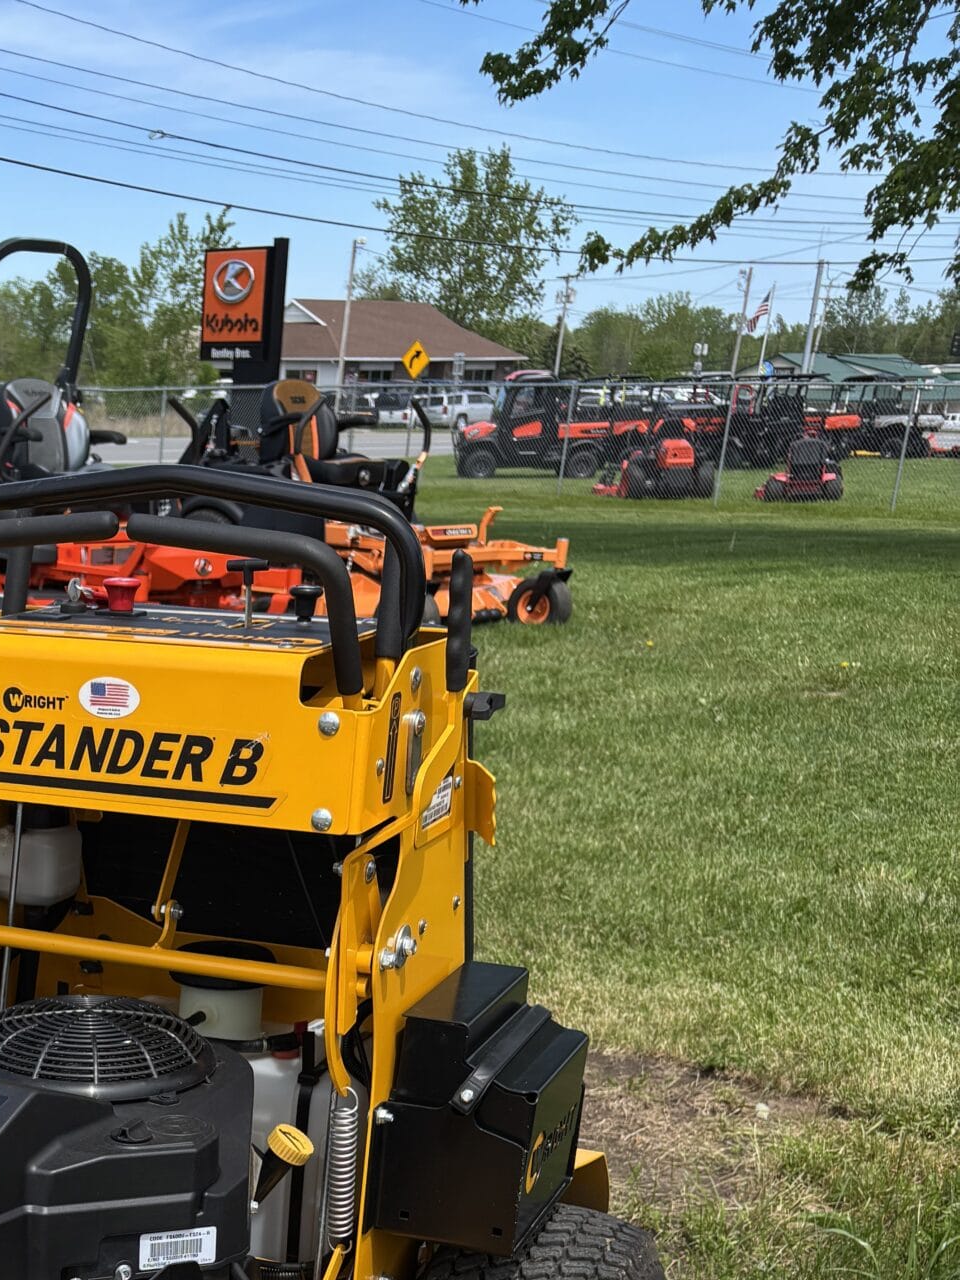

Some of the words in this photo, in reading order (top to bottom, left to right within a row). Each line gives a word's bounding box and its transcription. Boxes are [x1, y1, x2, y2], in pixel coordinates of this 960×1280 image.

[205, 313, 259, 334] Kubota
[3, 687, 66, 713] WRIGHT
[221, 738, 265, 786] B
